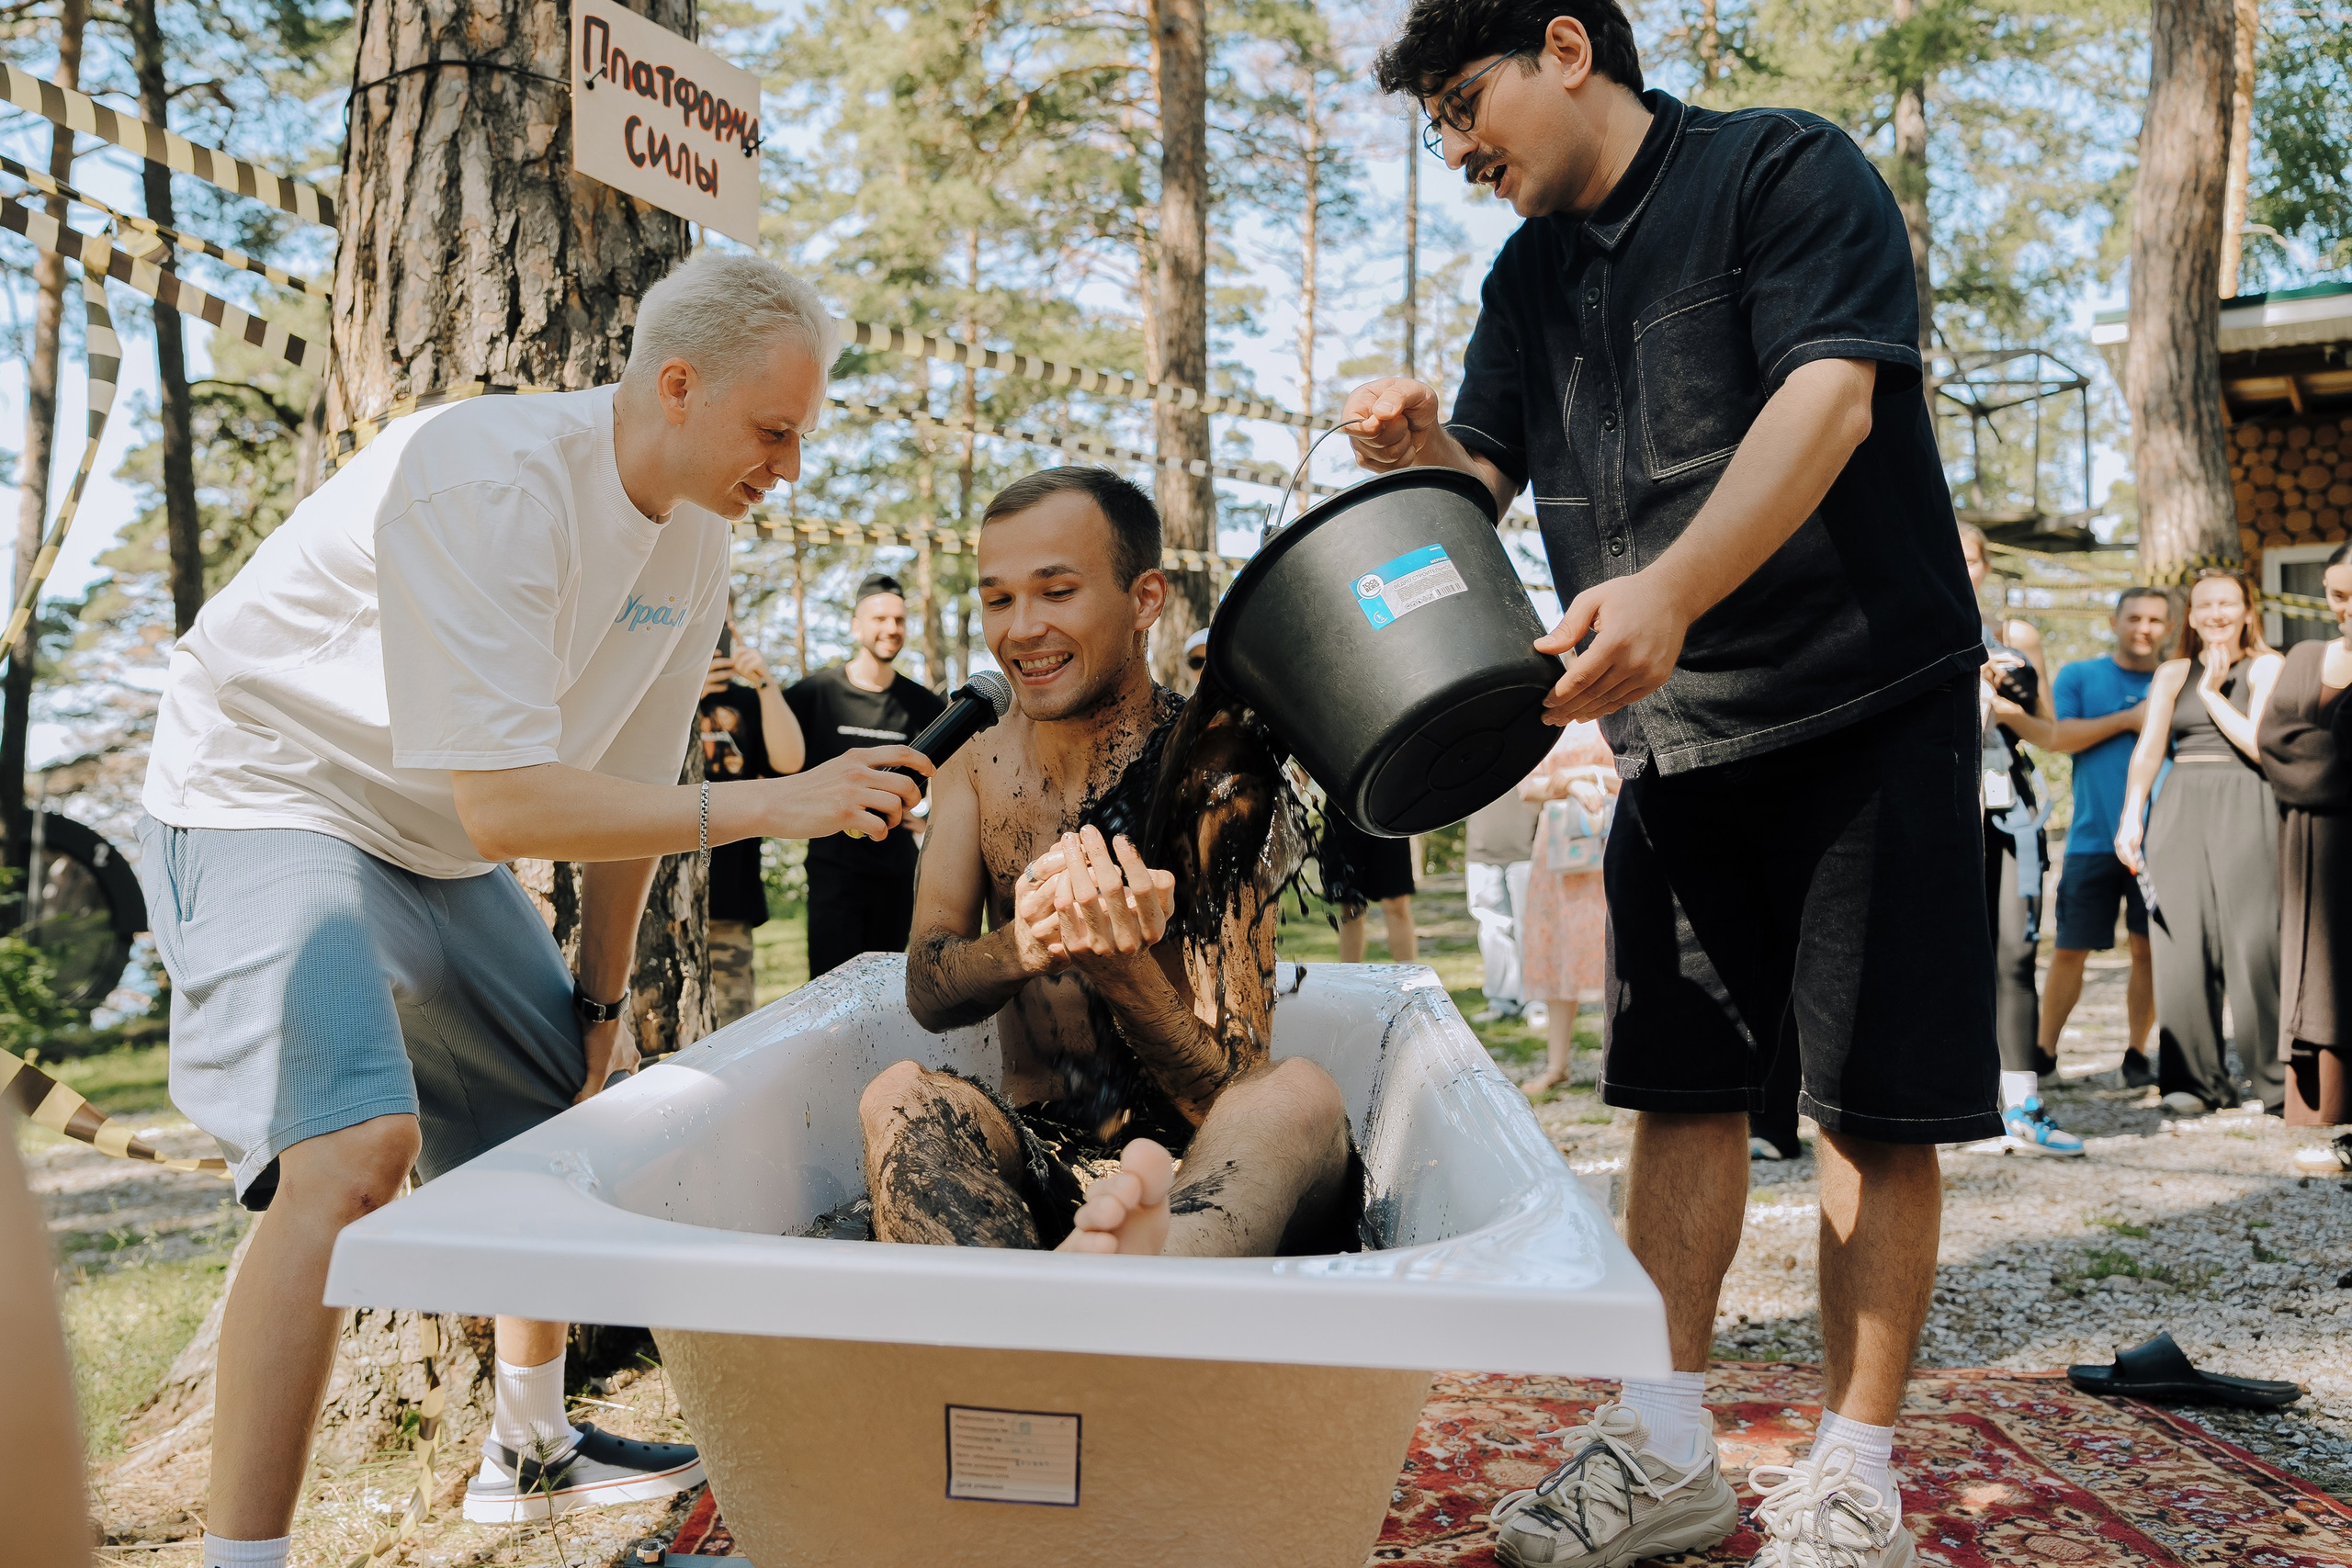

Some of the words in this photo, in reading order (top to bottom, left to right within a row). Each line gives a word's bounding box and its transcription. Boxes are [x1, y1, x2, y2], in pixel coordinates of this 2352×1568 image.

[625, 115, 718, 198] Силы
[1362, 578, 1378, 589] TOOL
[1393, 578, 1411, 589] ВЕДРО
[1412, 564, 1452, 580] СТРОИТЕЛЬНОЕ
